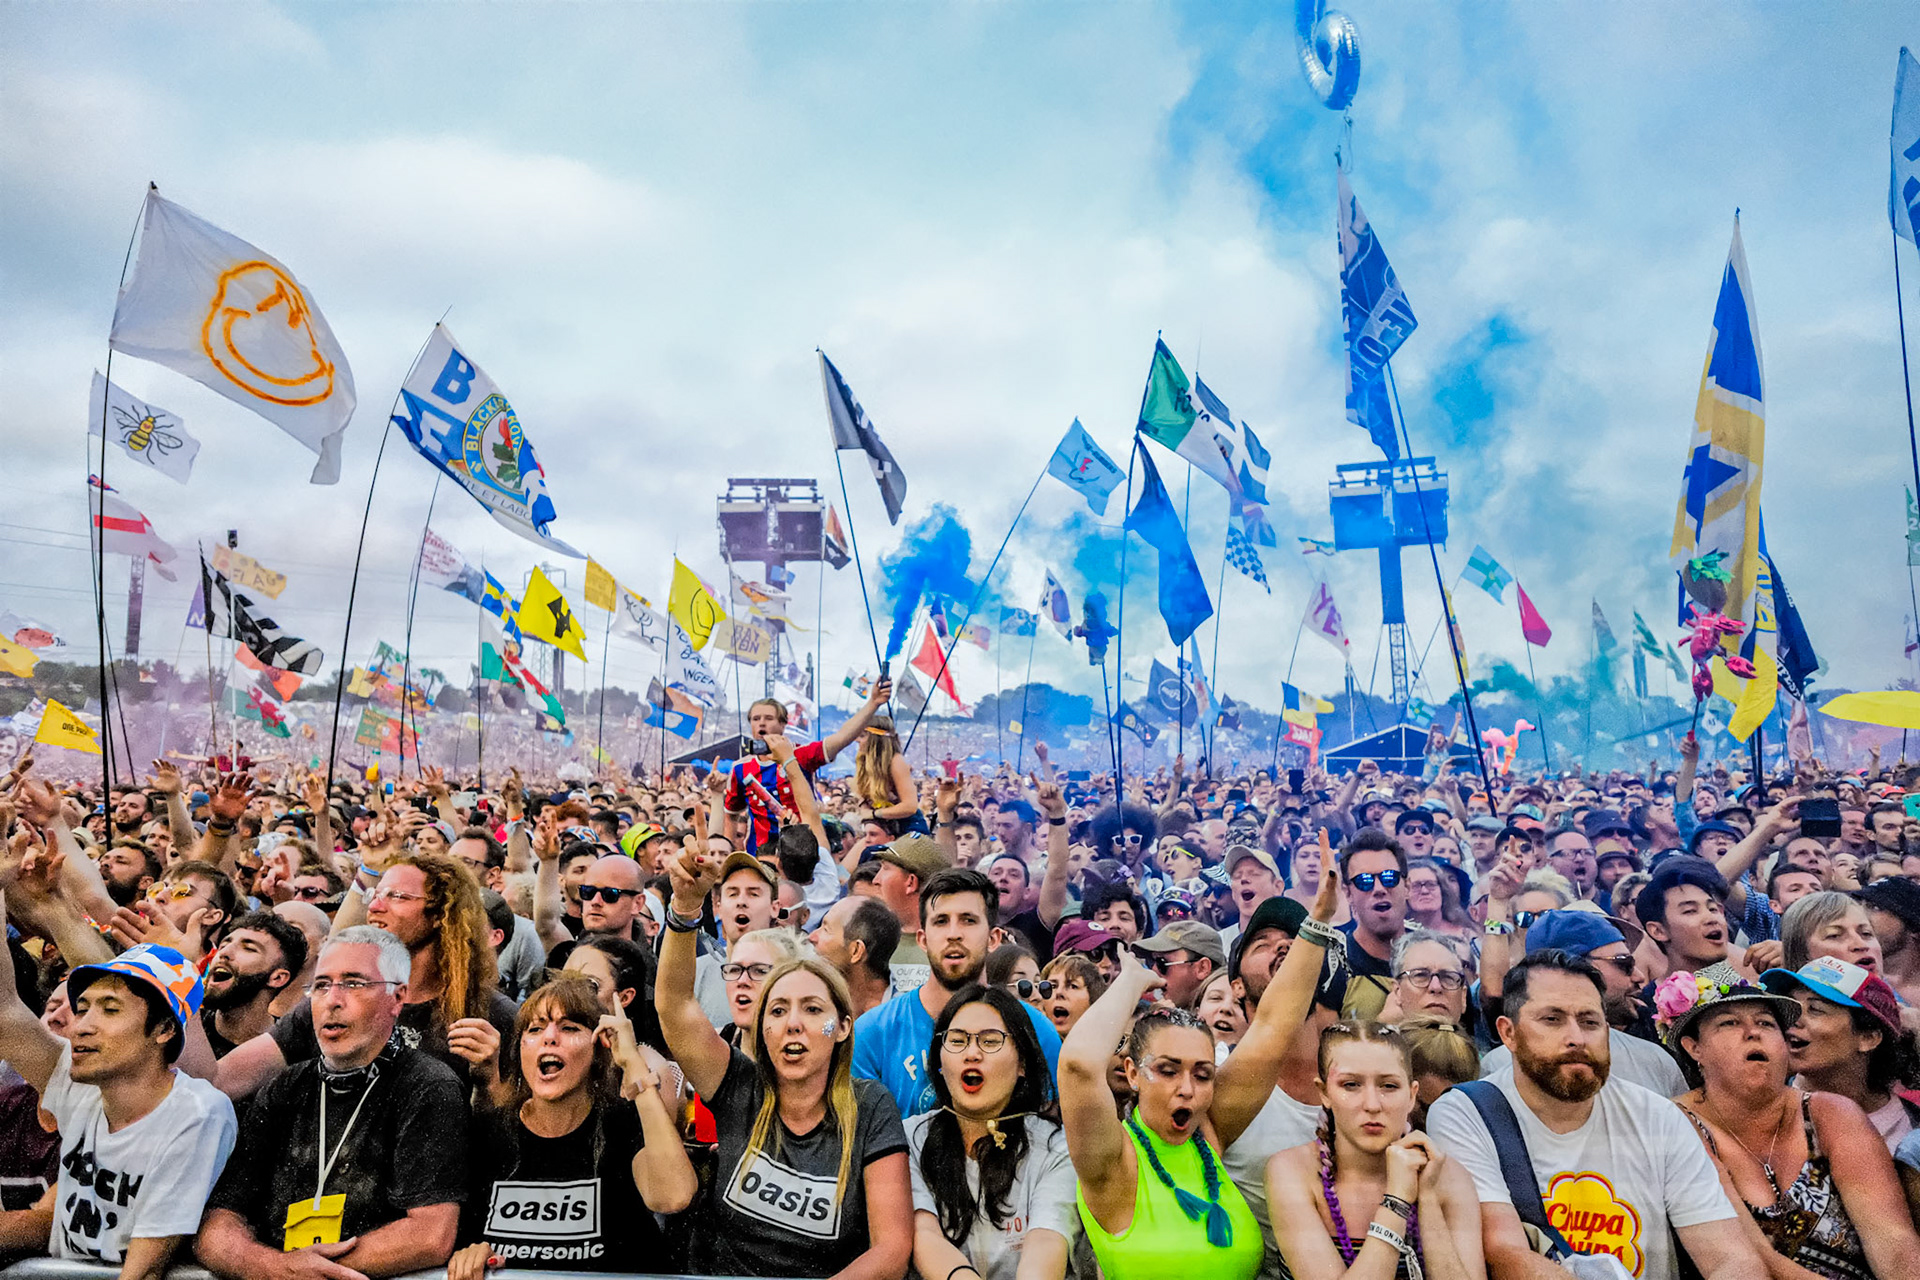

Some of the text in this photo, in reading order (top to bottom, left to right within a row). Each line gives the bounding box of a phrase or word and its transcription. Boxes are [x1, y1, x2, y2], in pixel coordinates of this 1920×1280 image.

[466, 396, 505, 451] BLACK
[500, 497, 533, 520] LABO
[896, 967, 915, 976] our
[500, 1194, 588, 1222] oasis
[740, 1171, 831, 1221] oasis
[1546, 1203, 1625, 1240] Chupa
[490, 1240, 605, 1260] upersonic
